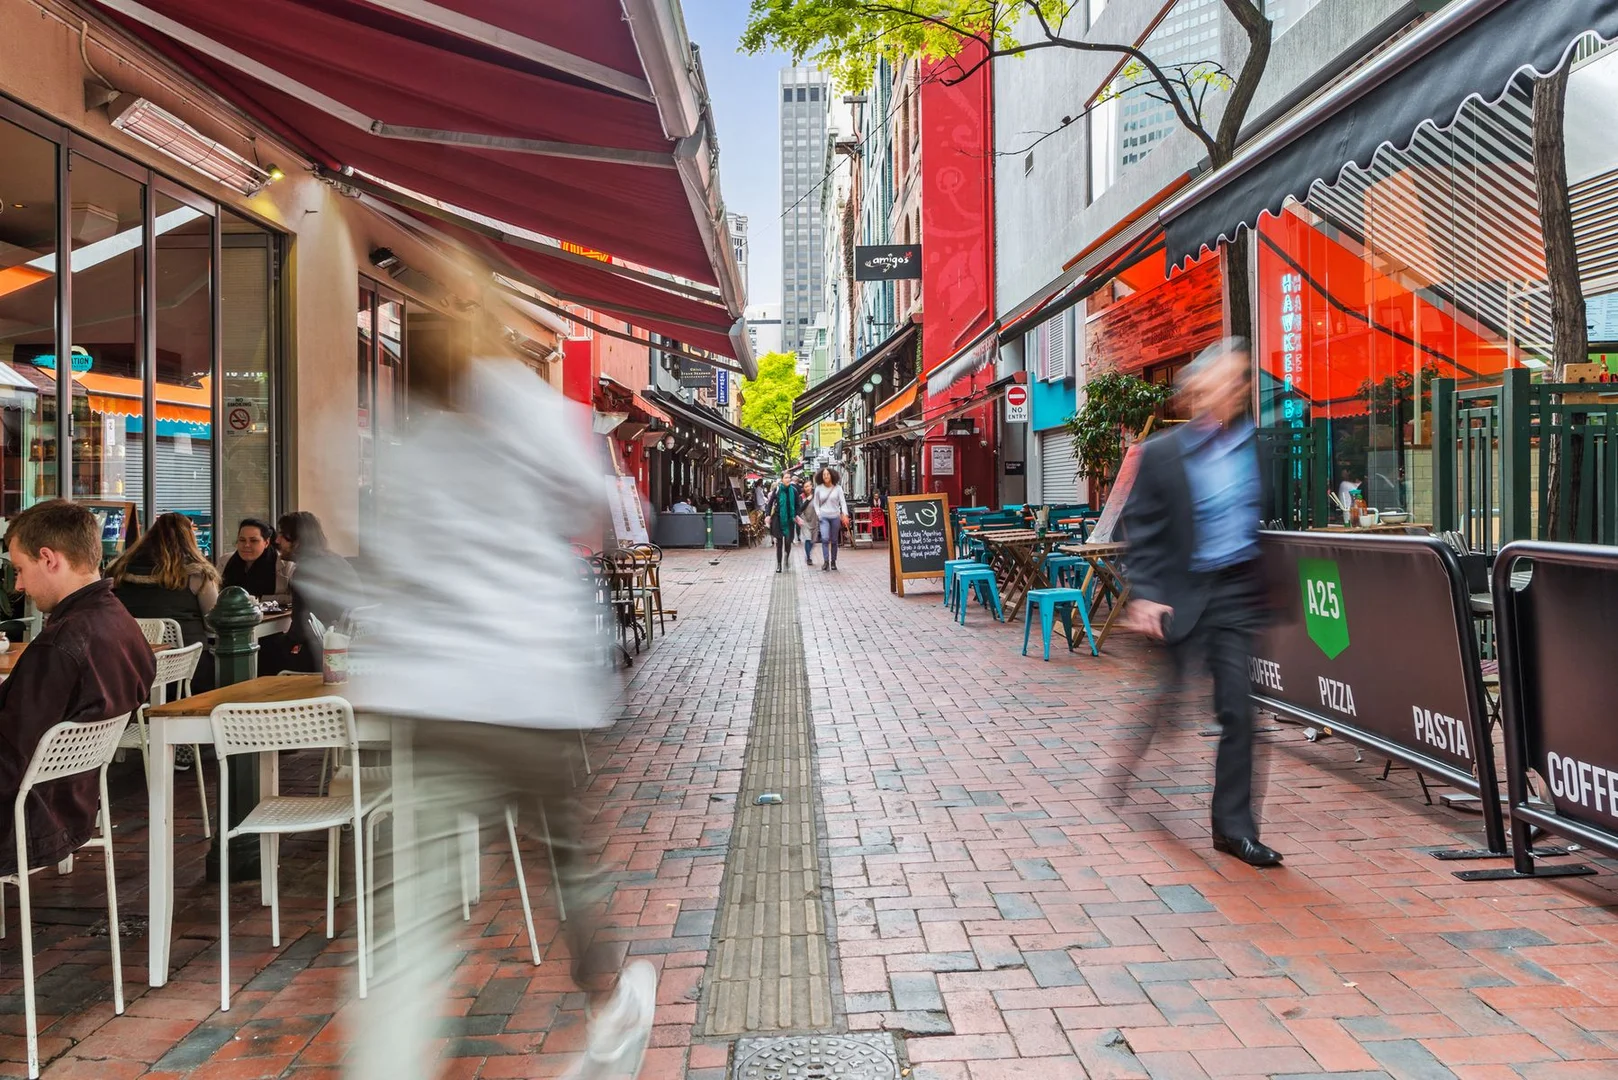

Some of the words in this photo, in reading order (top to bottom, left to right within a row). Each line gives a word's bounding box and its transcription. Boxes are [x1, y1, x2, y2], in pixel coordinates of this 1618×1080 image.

[872, 253, 909, 268] amigos
[1307, 579, 1340, 619] A25
[1247, 655, 1284, 691] COFFEE
[1318, 676, 1357, 716] PIZZA
[1412, 706, 1470, 759] PASTA
